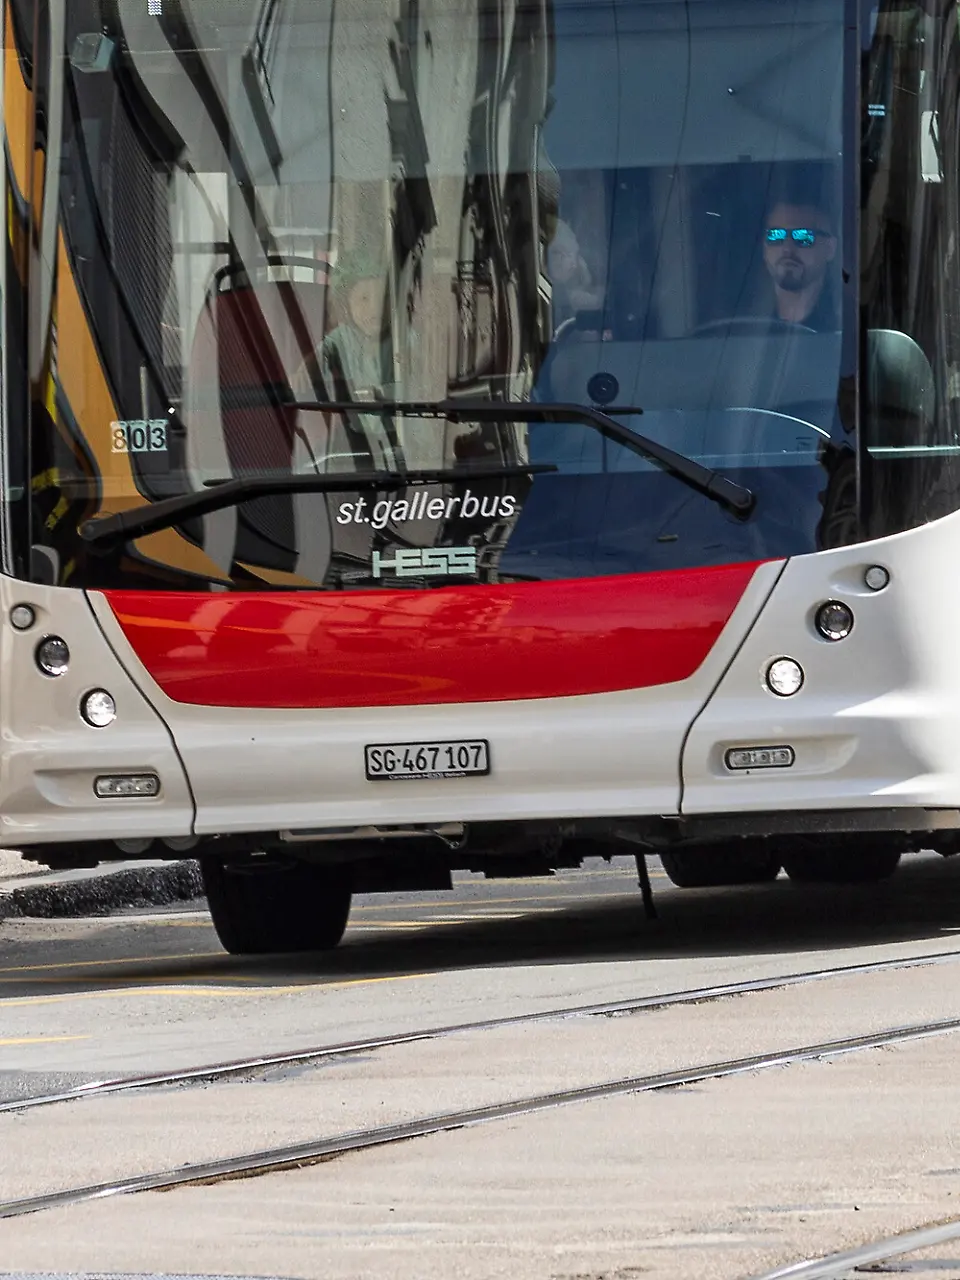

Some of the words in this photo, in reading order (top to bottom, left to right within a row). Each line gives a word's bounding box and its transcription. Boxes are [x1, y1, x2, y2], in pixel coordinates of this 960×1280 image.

[113, 427, 165, 450] 803
[336, 489, 516, 529] st.gallerbus
[372, 546, 476, 578] HESS
